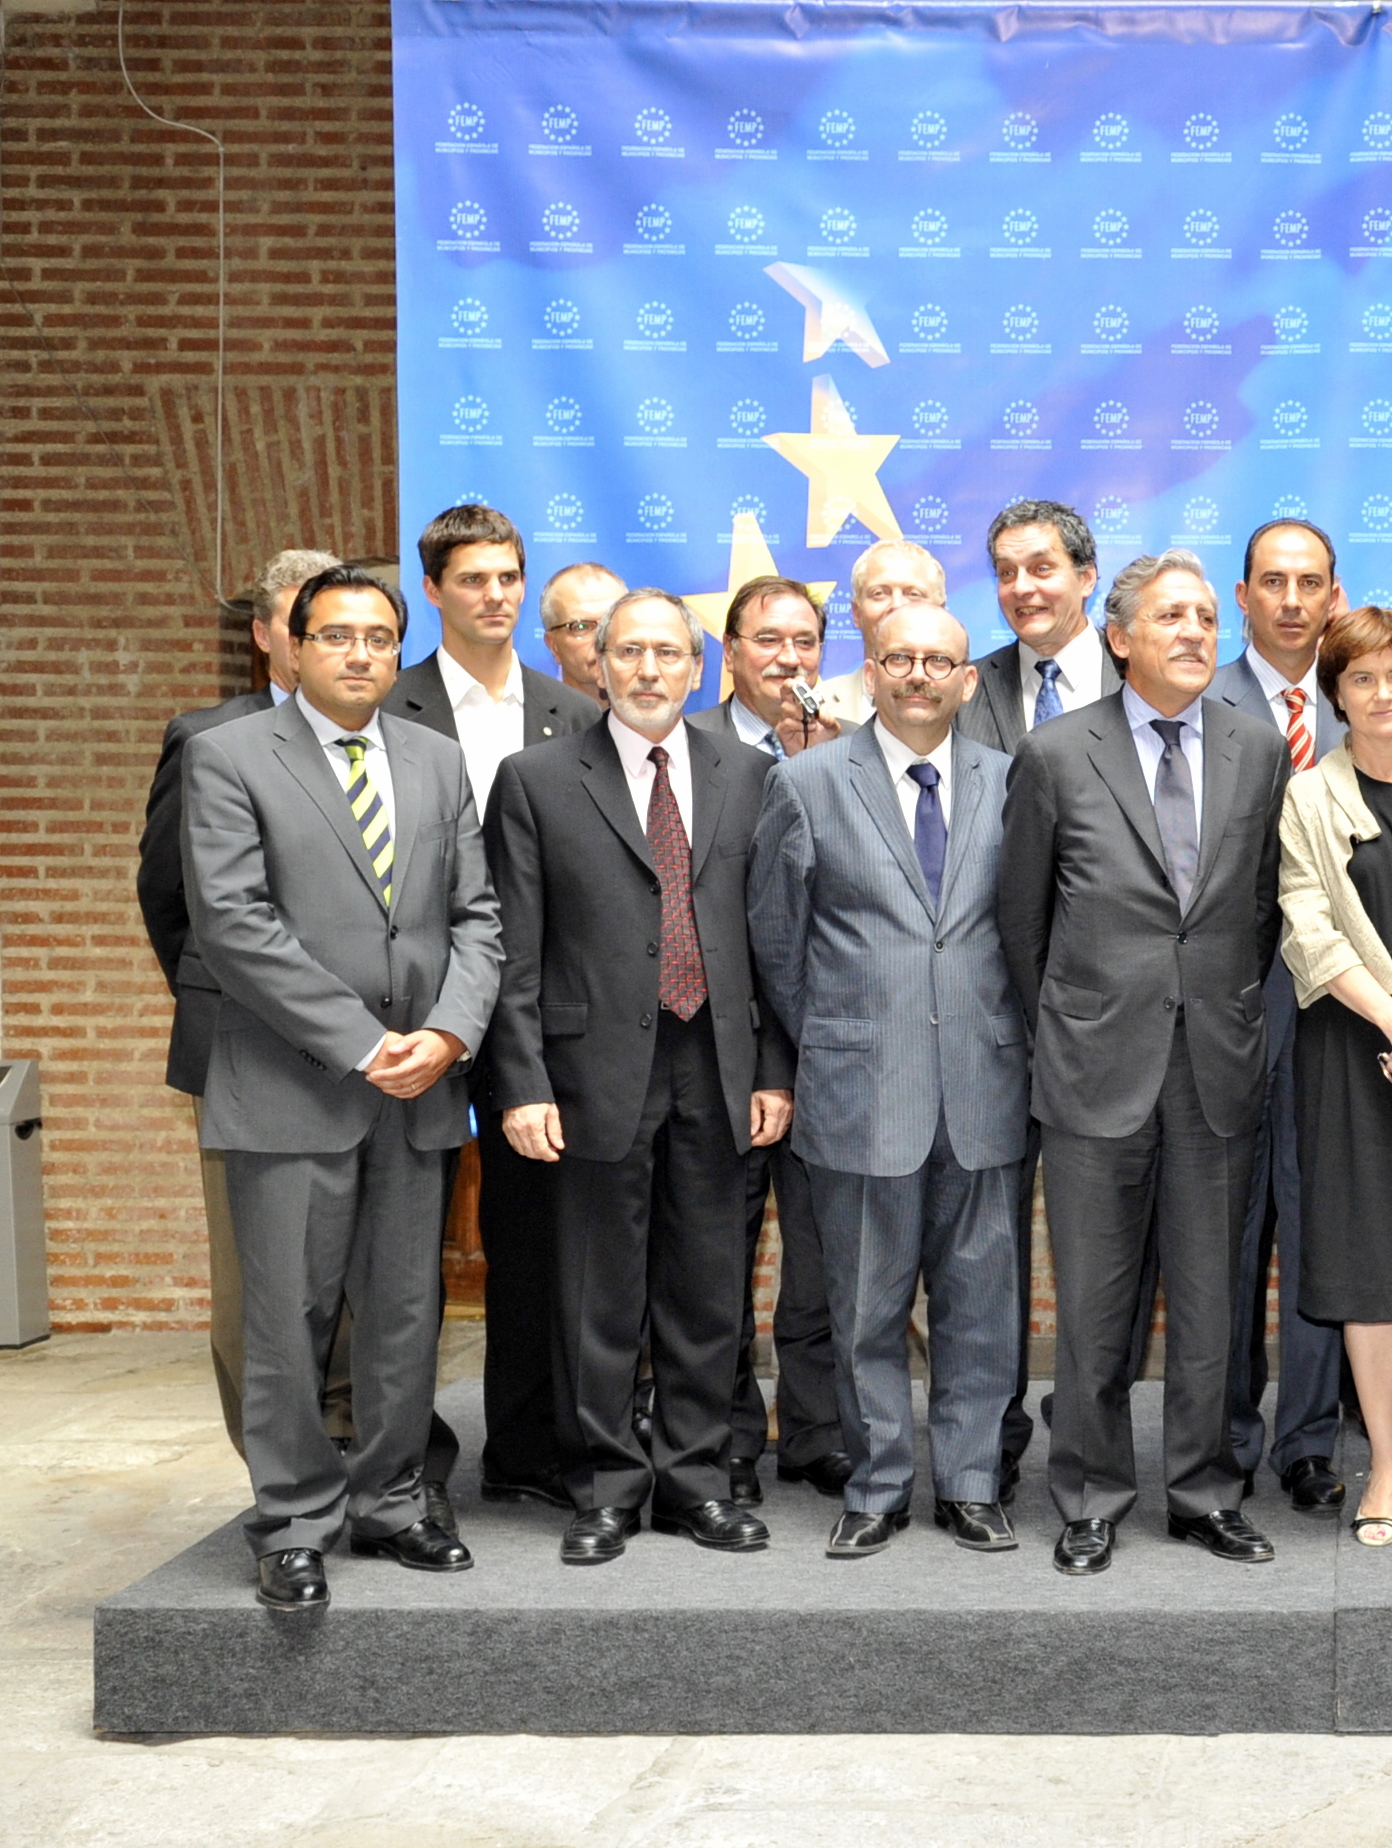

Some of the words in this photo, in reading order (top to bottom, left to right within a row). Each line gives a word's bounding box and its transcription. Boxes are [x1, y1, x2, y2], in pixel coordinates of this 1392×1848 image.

[455, 115, 478, 127] FEMP
[549, 117, 572, 129] FEMP
[642, 119, 665, 131] FEMP
[735, 121, 757, 133] FEMP
[826, 122, 849, 134] FEMP
[918, 123, 940, 135] FEMP
[1009, 124, 1031, 136] FEMP
[1100, 125, 1122, 136] FEMP
[1190, 125, 1212, 137] FEMP
[1281, 125, 1302, 137] FEMP
[1369, 124, 1391, 136] FEMP
[457, 213, 480, 225] FEMP
[550, 214, 573, 226] FEMP
[643, 216, 665, 228] FEMP
[735, 218, 758, 229] FEMP
[827, 220, 850, 231] FEMP
[919, 221, 941, 232] FEMP
[1010, 221, 1032, 232] FEMP
[1100, 221, 1122, 232] FEMP
[1190, 221, 1212, 232] FEMP
[1280, 222, 1302, 234] FEMP
[1369, 220, 1391, 231] FEMP
[458, 310, 481, 322] FEMP
[551, 312, 573, 323] FEMP
[644, 314, 667, 325] FEMP
[736, 314, 758, 326] FEMP
[919, 316, 941, 327] FEMP
[1010, 316, 1032, 328] FEMP
[1369, 316, 1391, 327] FEMP
[1100, 317, 1122, 328] FEMP
[1191, 317, 1212, 329] FEMP
[1280, 317, 1302, 329] FEMP
[460, 408, 482, 419] FEMP
[553, 409, 575, 420] FEMP
[644, 409, 667, 421] FEMP
[737, 411, 759, 422] FEMP
[920, 412, 941, 423] FEMP
[1010, 412, 1032, 424] FEMP
[1100, 412, 1122, 424] FEMP
[1190, 413, 1212, 424] FEMP
[1280, 412, 1301, 424] FEMP
[1369, 411, 1390, 422] FEMP
[554, 505, 577, 517] FEMP
[645, 505, 667, 517] FEMP
[920, 508, 942, 519] FEMP
[1101, 508, 1122, 520] FEMP
[1190, 508, 1212, 519] FEMP
[1280, 507, 1301, 519] FEMP
[1368, 506, 1390, 517] FEMP
[829, 603, 851, 615] FEMP
